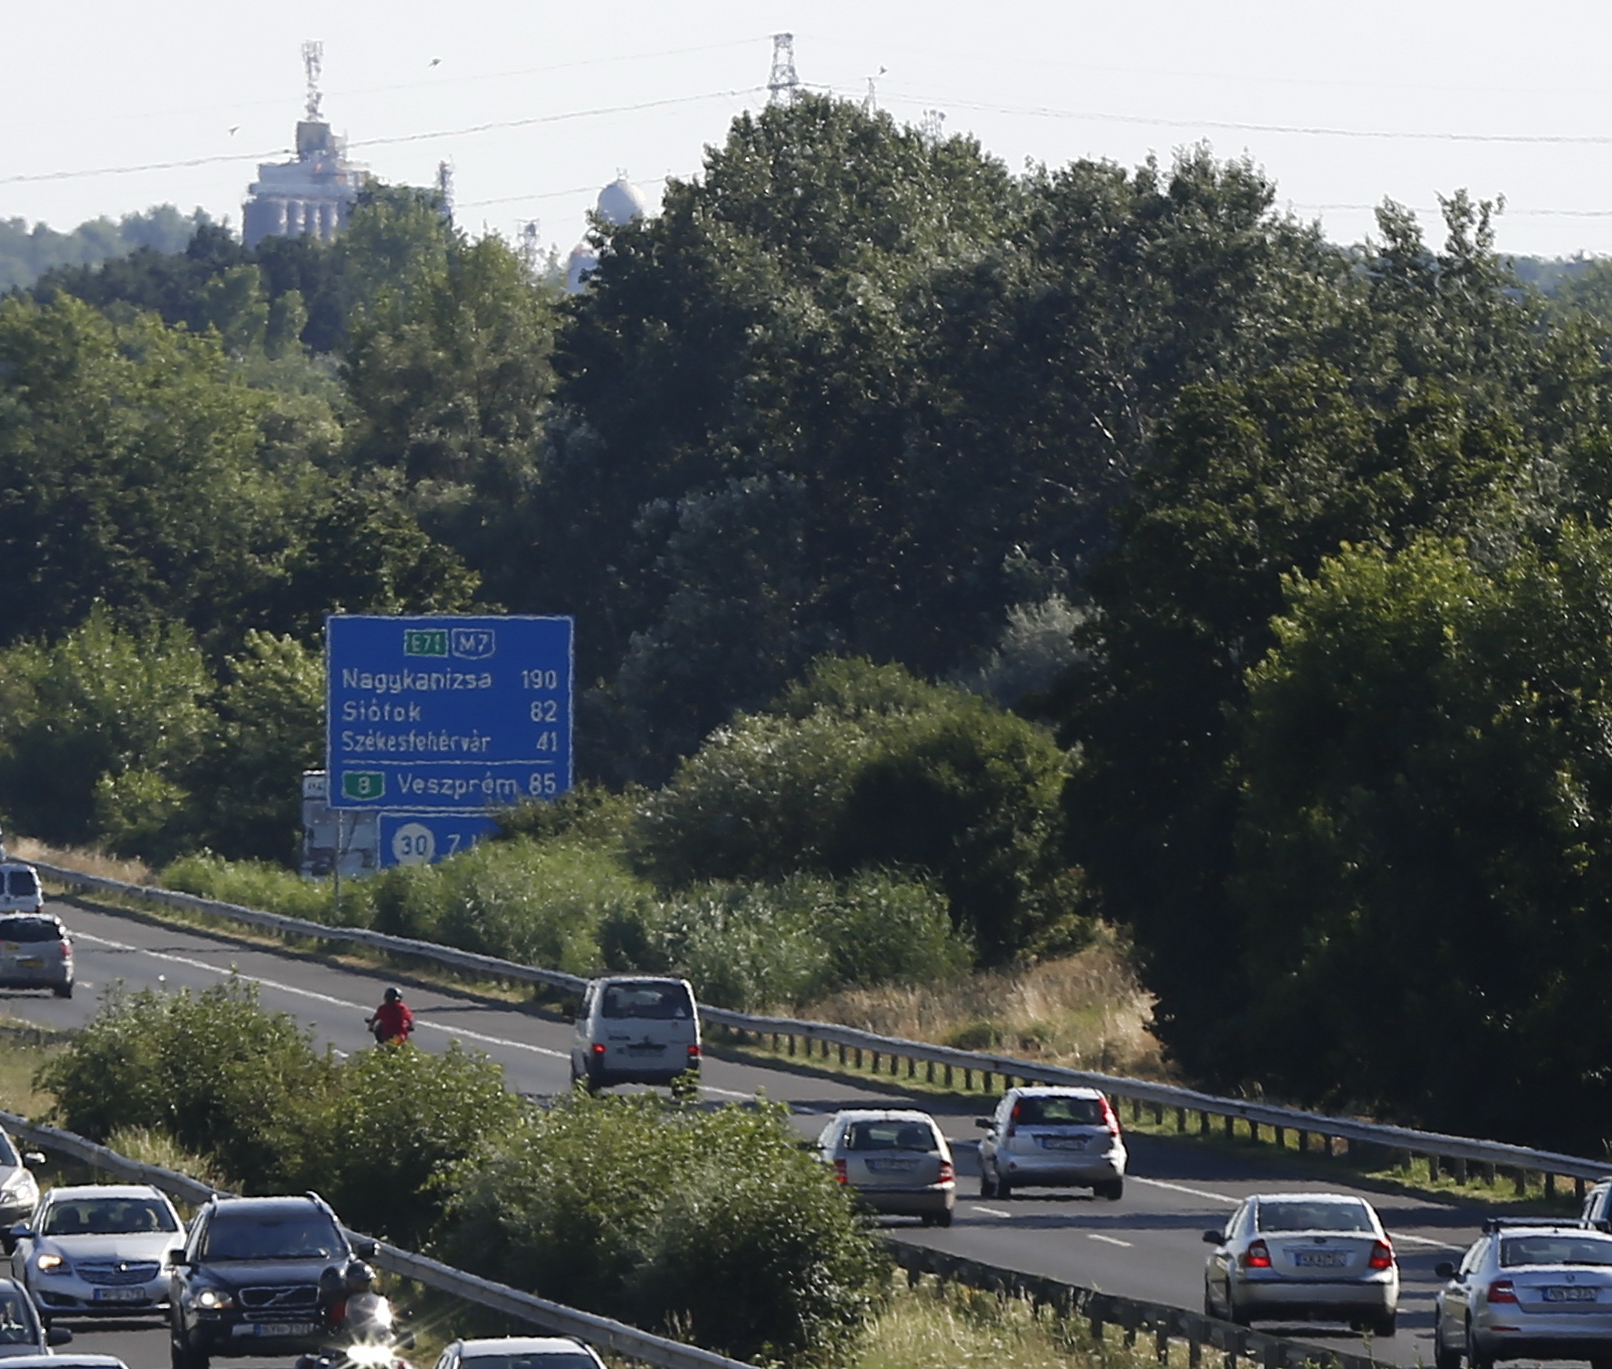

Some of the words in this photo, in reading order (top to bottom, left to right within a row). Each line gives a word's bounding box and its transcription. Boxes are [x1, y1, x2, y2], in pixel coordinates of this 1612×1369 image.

[411, 634, 440, 651] E71
[460, 634, 488, 651] M7
[342, 668, 492, 694] Nagykanizsa
[521, 669, 557, 690] 190
[342, 698, 421, 722] Siófok
[530, 701, 557, 722] 82
[342, 729, 491, 752] Székesfehérvár
[536, 731, 557, 751] 41
[358, 776, 370, 794] 8
[397, 772, 517, 800] Veszprém
[400, 835, 427, 855] 30
